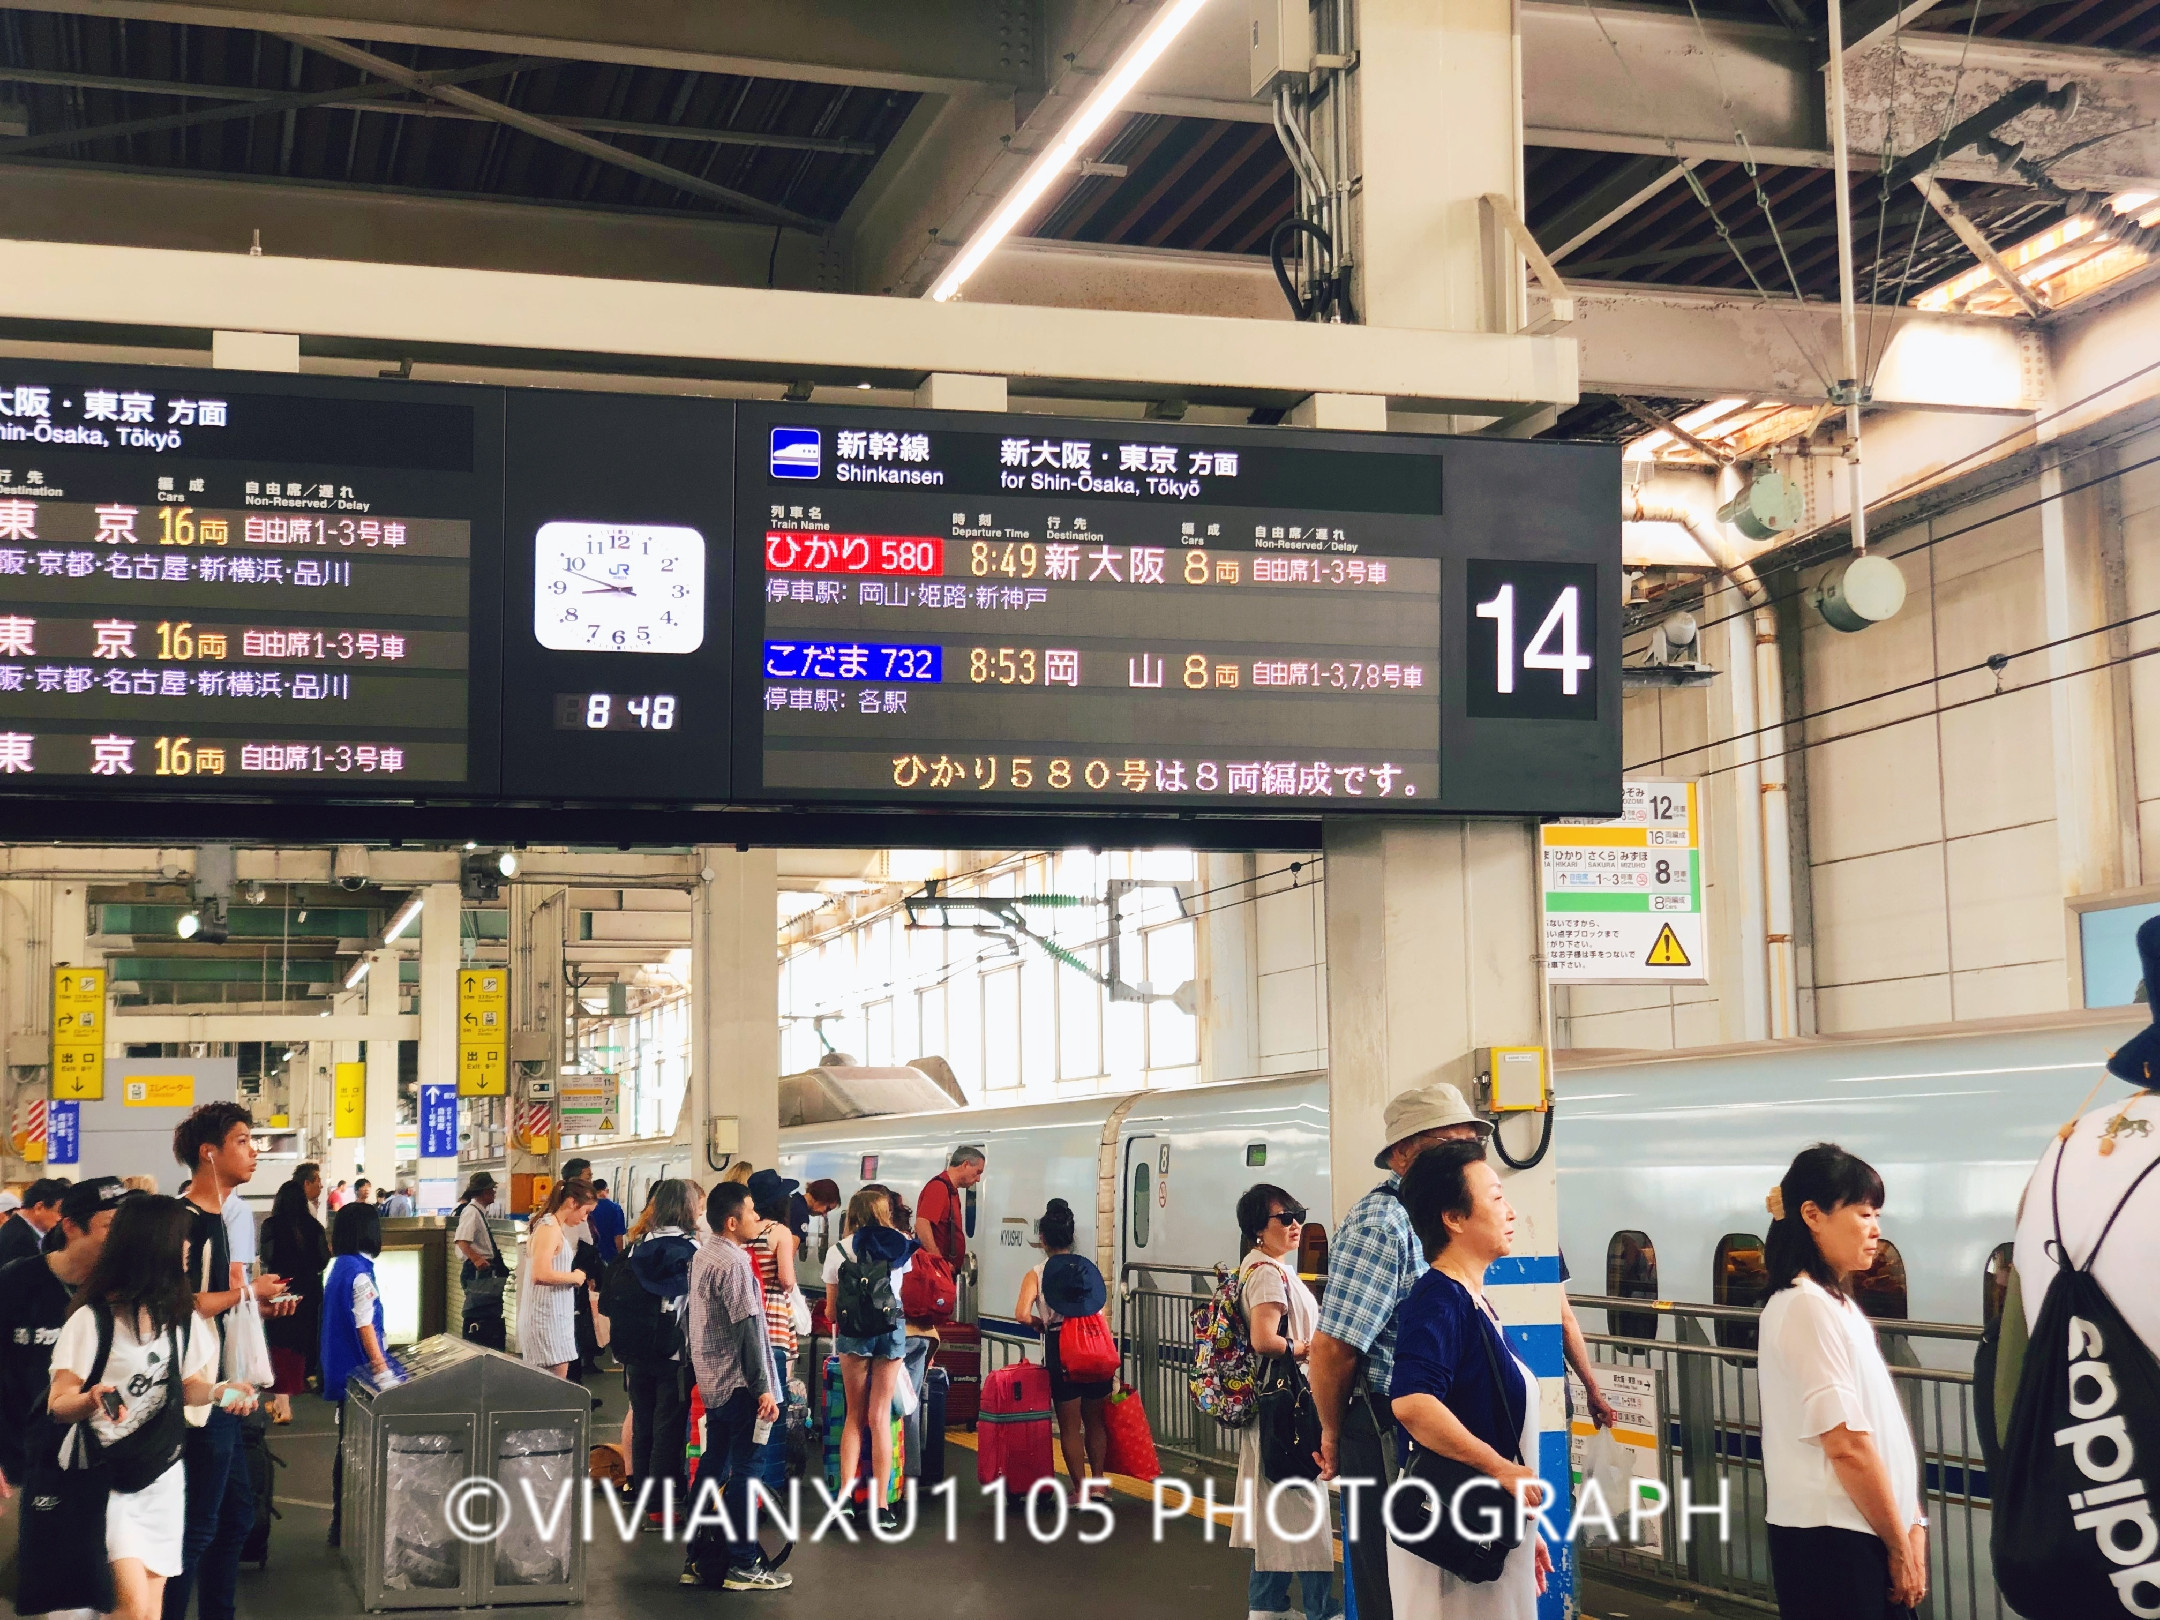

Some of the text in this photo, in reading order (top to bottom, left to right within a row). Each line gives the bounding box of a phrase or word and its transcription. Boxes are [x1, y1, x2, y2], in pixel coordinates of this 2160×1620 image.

[167, 398, 227, 426] 方面
[116, 425, 182, 452] Tōkyō
[836, 431, 930, 463] 新幹線
[1000, 438, 1239, 477] 新大阪・東京 方面
[836, 463, 943, 485] Shinkansen
[1001, 470, 1200, 499] for Shin-Ōsaka, Tōkyō
[157, 492, 185, 502] Cars
[771, 519, 830, 531] Train Name
[244, 517, 407, 548] 自由席1-3号車
[952, 527, 1030, 539] Departure Time
[1047, 530, 1104, 542] Destination
[609, 535, 630, 549] 12
[1181, 535, 1204, 546] Cars
[587, 541, 603, 555] 11
[642, 541, 649, 555] 1
[564, 557, 586, 571] 10
[661, 559, 674, 572] 2
[767, 536, 870, 570] ひかり
[881, 541, 934, 571] 580
[971, 541, 1037, 578] 8:49
[1253, 557, 1387, 585] 自由席1-3号車
[609, 564, 630, 575] JR
[553, 581, 567, 595] 9
[672, 585, 684, 598] 3
[565, 608, 578, 621] 8
[660, 611, 673, 624] 4
[588, 625, 600, 639] 7
[612, 631, 625, 644] 6
[637, 626, 650, 640] 5
[1475, 583, 1592, 695] 14
[242, 630, 407, 661] 自由席1-3号車
[766, 644, 869, 678] こだま
[880, 648, 932, 678] 732
[970, 647, 1036, 685] 8:53
[1251, 661, 1423, 690] 自由席1-3,7,8号車
[858, 688, 907, 714] 各駅
[587, 694, 675, 729] 8 48
[241, 744, 405, 774] 自由席1-3号車
[1649, 796, 1673, 820] 12
[1649, 831, 1664, 845] 16
[1556, 851, 1582, 860] ひかり
[1588, 851, 1616, 861] さくら
[1620, 851, 1648, 861] みずほ
[1655, 859, 1671, 885] 8
[1654, 896, 1665, 910] 8
[467, 1052, 498, 1061] 出口
[604, 1097, 610, 1105] 7
[1161, 1146, 1168, 1172] 8
[2054, 1315, 2160, 1620] adidas
